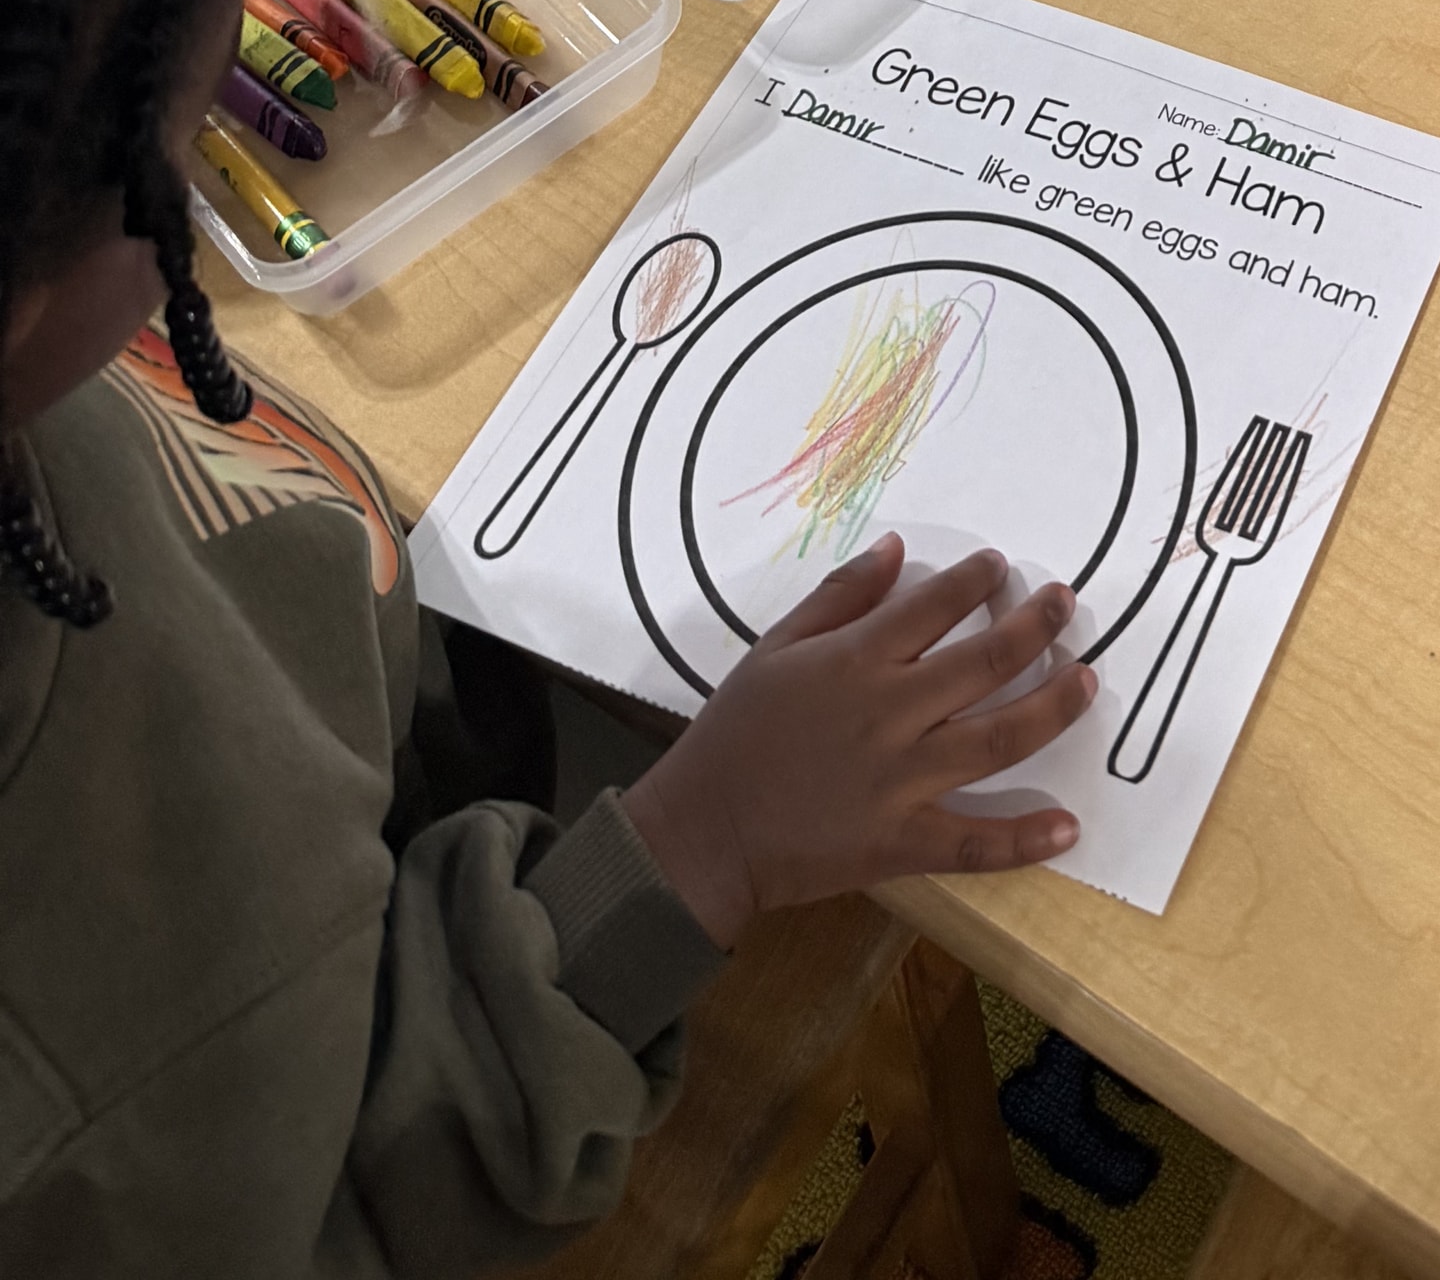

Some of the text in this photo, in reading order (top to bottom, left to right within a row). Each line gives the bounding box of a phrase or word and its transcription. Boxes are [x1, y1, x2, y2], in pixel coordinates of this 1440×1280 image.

[754, 77, 786, 109] I
[783, 88, 885, 146] Damir
[1158, 103, 1222, 140] Name:
[870, 45, 1328, 236] Green Eggs & Ham
[1225, 115, 1337, 173] Damir
[977, 155, 1382, 321] like green eggs and ham.
